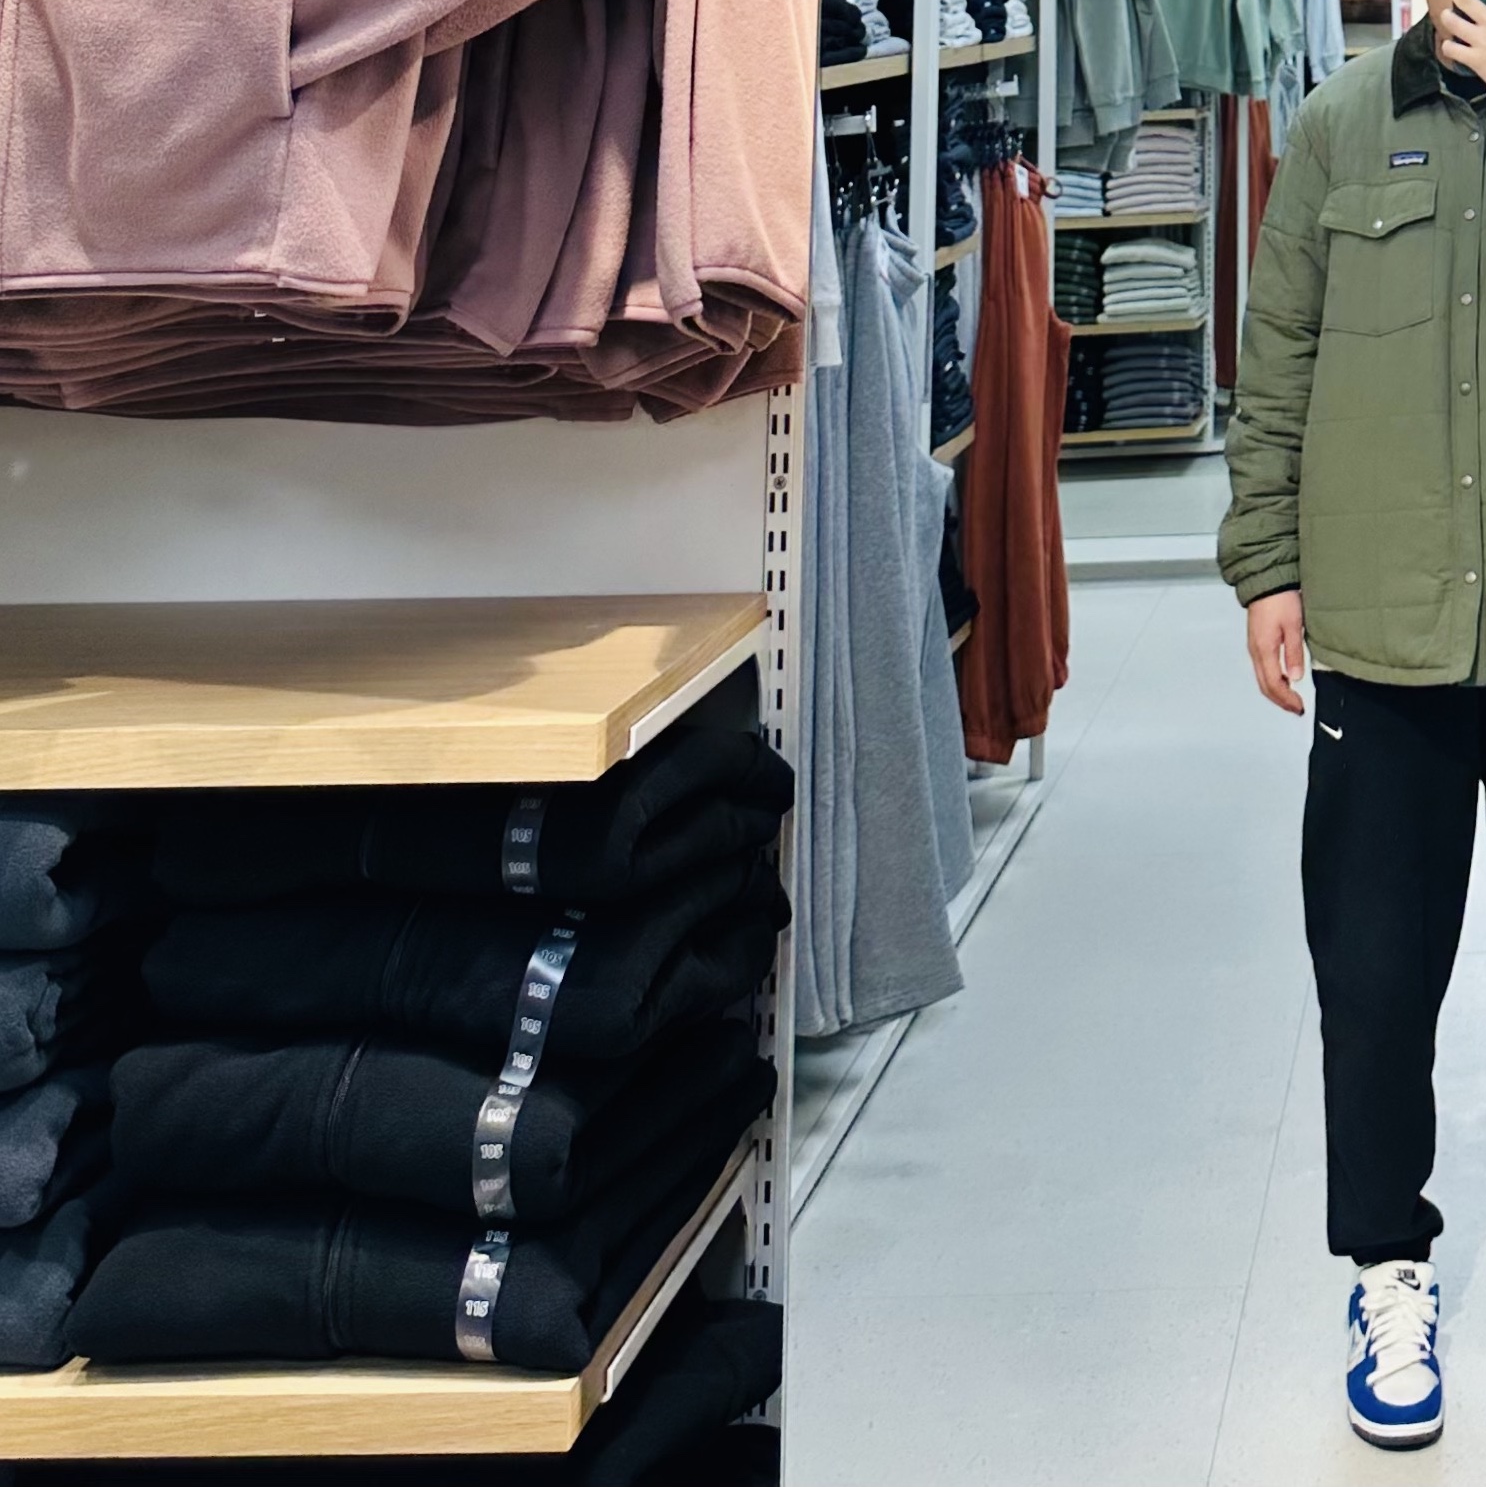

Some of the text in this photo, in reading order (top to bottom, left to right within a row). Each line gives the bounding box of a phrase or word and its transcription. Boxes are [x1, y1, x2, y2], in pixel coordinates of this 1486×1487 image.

[511, 828, 532, 843] 105
[509, 862, 530, 874] 105
[541, 950, 564, 963] 105
[528, 983, 551, 999] 105
[521, 1017, 542, 1033] 105
[512, 1052, 533, 1069] 105
[487, 1108, 512, 1122] 105
[480, 1144, 504, 1159] 105
[486, 1230, 508, 1242] 115
[474, 1263, 498, 1278] 115
[466, 1300, 490, 1317] 115
